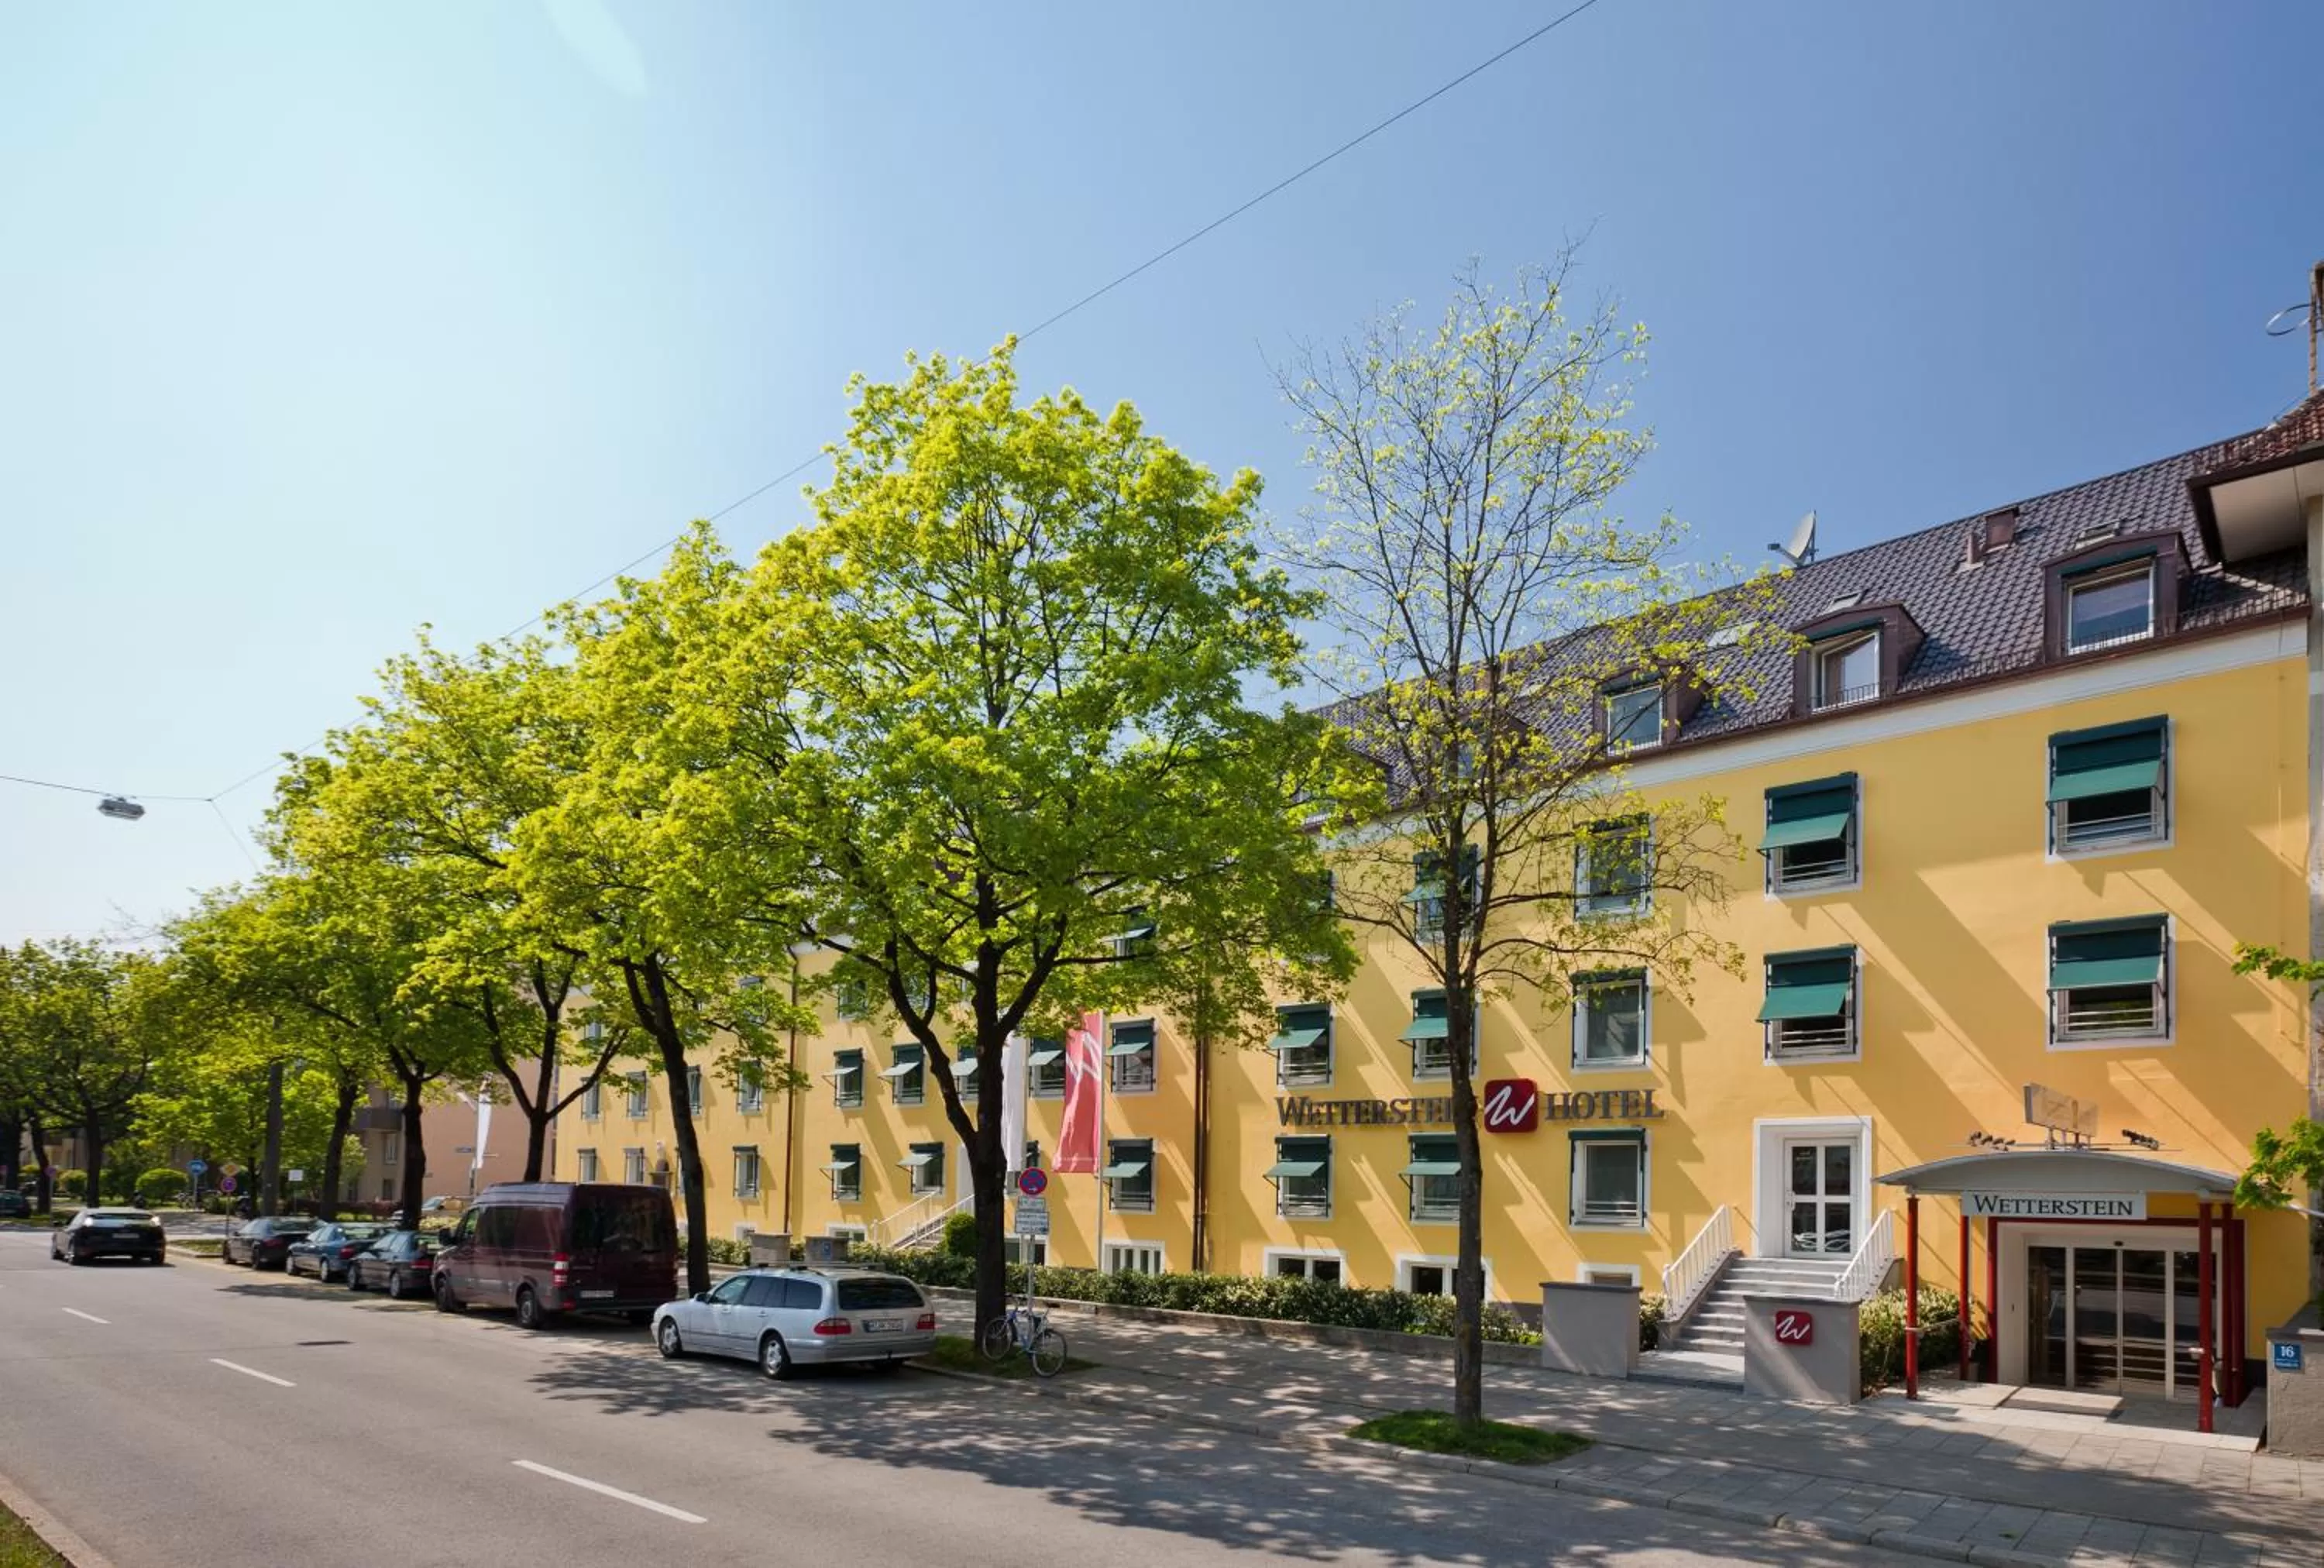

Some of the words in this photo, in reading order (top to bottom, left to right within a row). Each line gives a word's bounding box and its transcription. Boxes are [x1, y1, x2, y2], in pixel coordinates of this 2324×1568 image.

[1274, 1096, 1478, 1126] WETTERSTEI
[1545, 1088, 1665, 1119] HOTEL
[1973, 1195, 2133, 1216] WETTERSTEIN
[2281, 1346, 2295, 1357] 16
